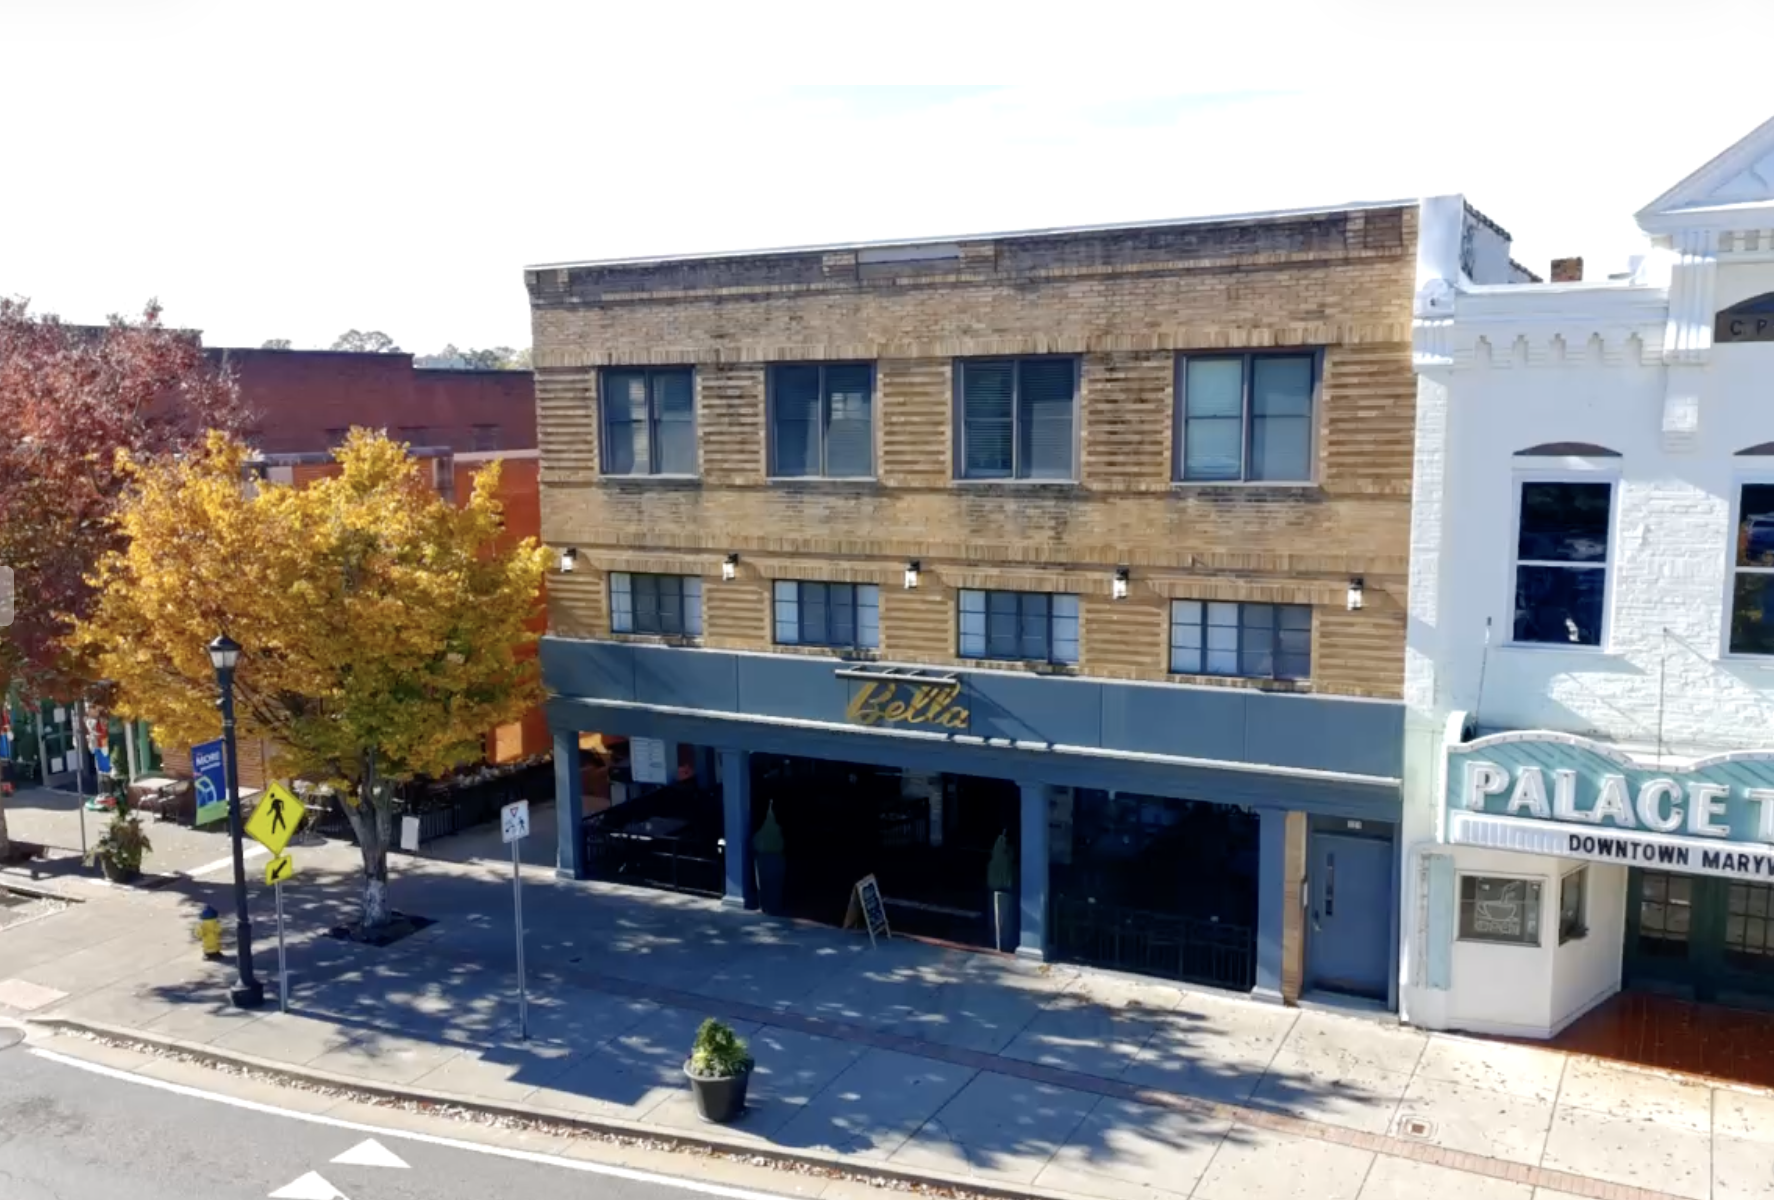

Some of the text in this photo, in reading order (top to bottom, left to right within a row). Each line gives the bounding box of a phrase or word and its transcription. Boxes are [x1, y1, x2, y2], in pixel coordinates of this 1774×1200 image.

[846, 680, 970, 728] Bella
[1463, 760, 1731, 838] PALACE
[1568, 834, 1689, 866] DOWNTOWN
